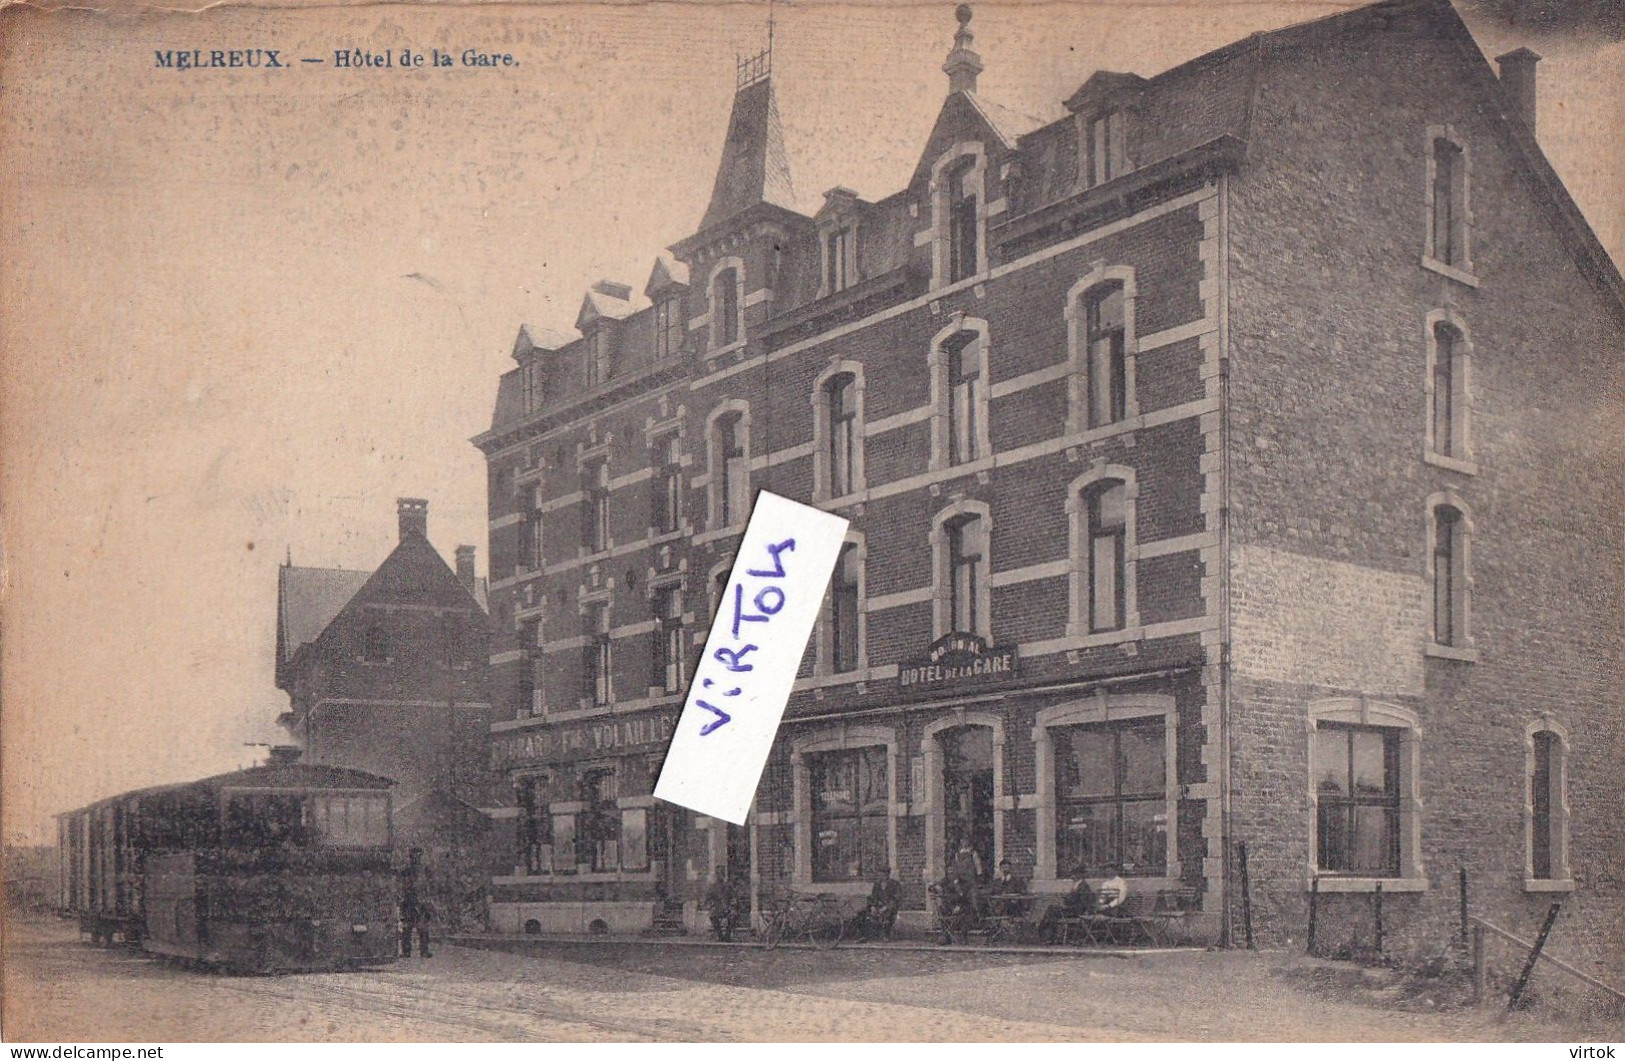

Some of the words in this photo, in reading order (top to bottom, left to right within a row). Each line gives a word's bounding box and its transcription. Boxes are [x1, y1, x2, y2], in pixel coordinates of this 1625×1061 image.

[945, 669, 957, 679] DE
[960, 666, 972, 677] LA
[974, 655, 1011, 674] GARE
